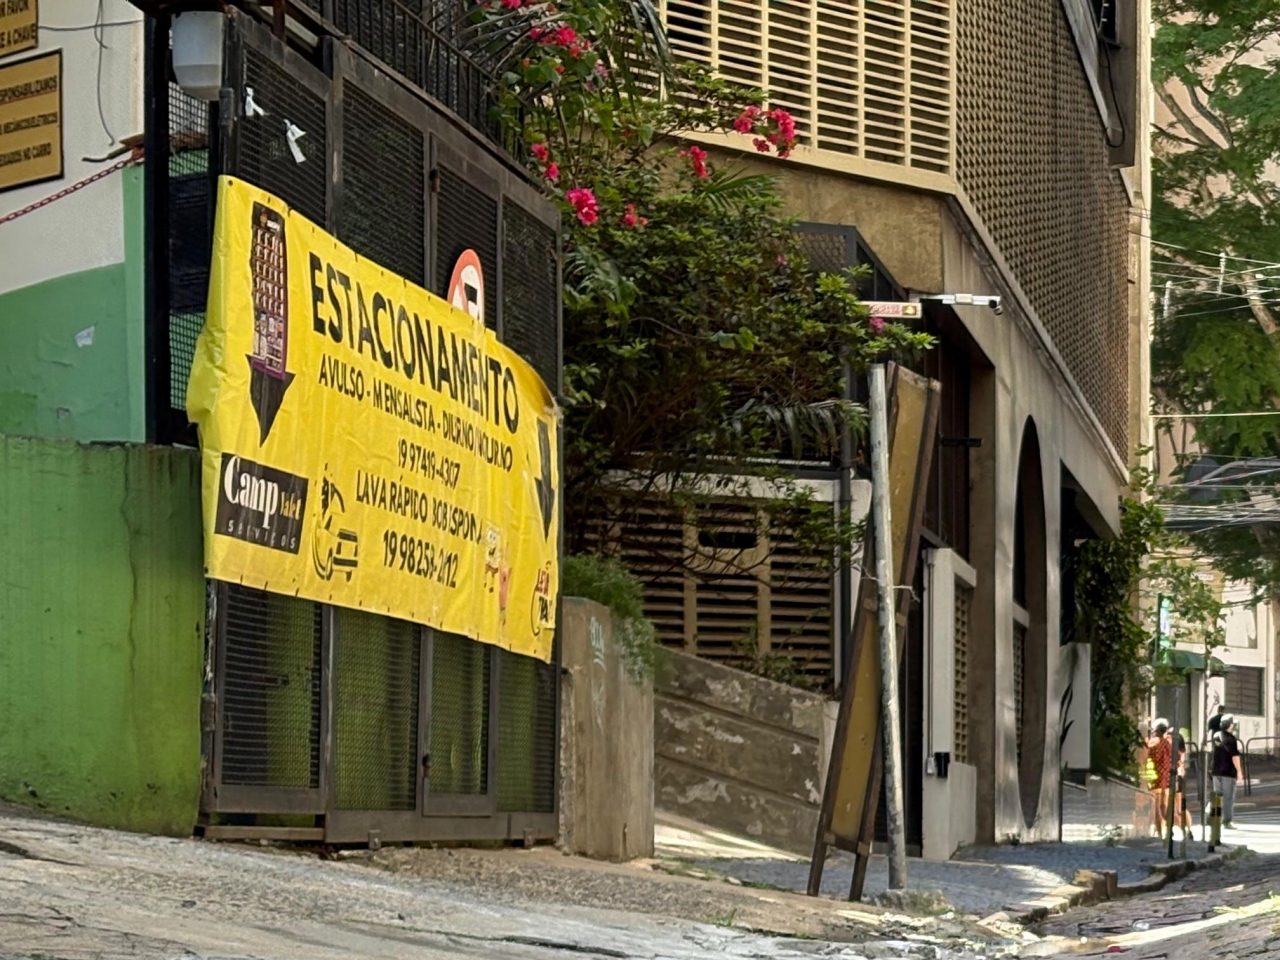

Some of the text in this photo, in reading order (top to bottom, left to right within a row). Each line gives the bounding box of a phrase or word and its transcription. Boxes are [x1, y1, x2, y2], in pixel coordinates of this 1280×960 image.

[309, 251, 519, 434] ESTACIONAMENTO
[319, 353, 364, 402] AVULSO
[373, 377, 436, 434] MENSALSTA
[224, 455, 279, 530] Camp
[356, 469, 387, 510] LAVA
[389, 474, 428, 523] RÁPIDO
[383, 529, 397, 567] 19
